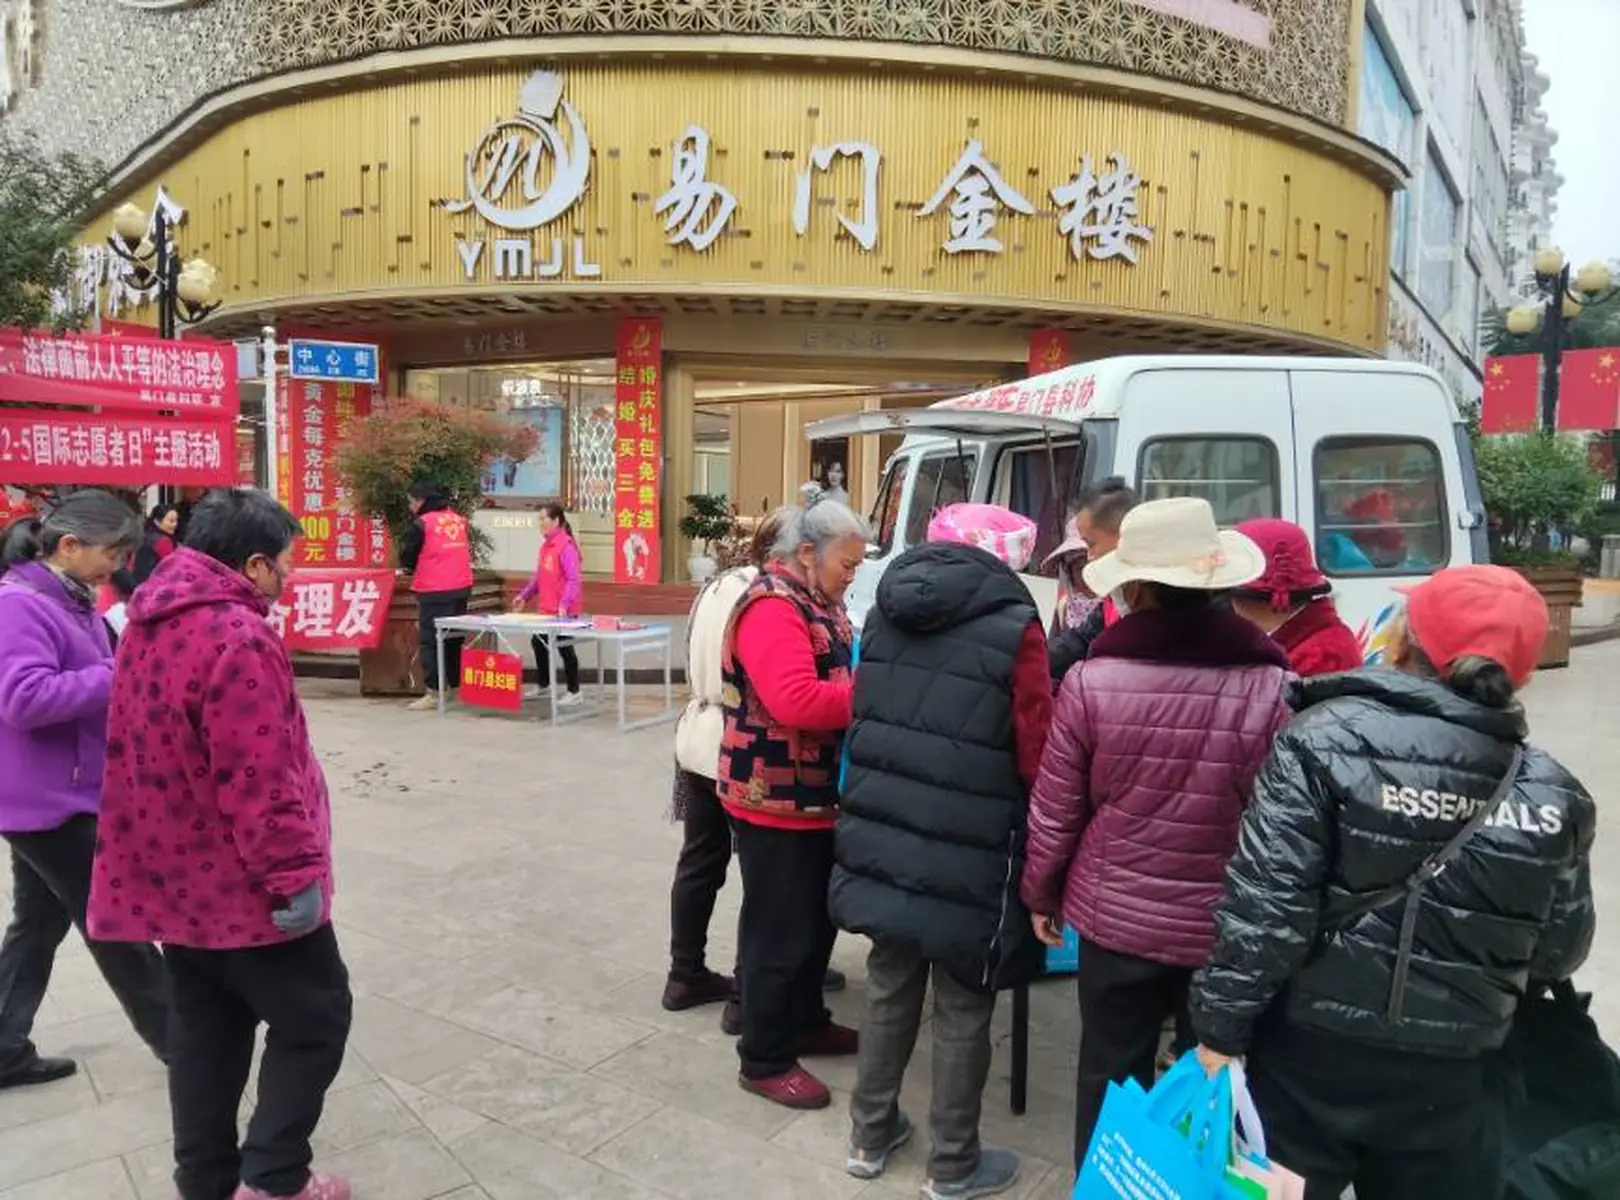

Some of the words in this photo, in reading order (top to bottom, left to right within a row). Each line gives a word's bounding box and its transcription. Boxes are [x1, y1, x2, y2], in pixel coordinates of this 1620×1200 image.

[655, 123, 1155, 264] 易门金楼
[456, 239, 600, 279] YMJL
[296, 346, 373, 367] 中心街
